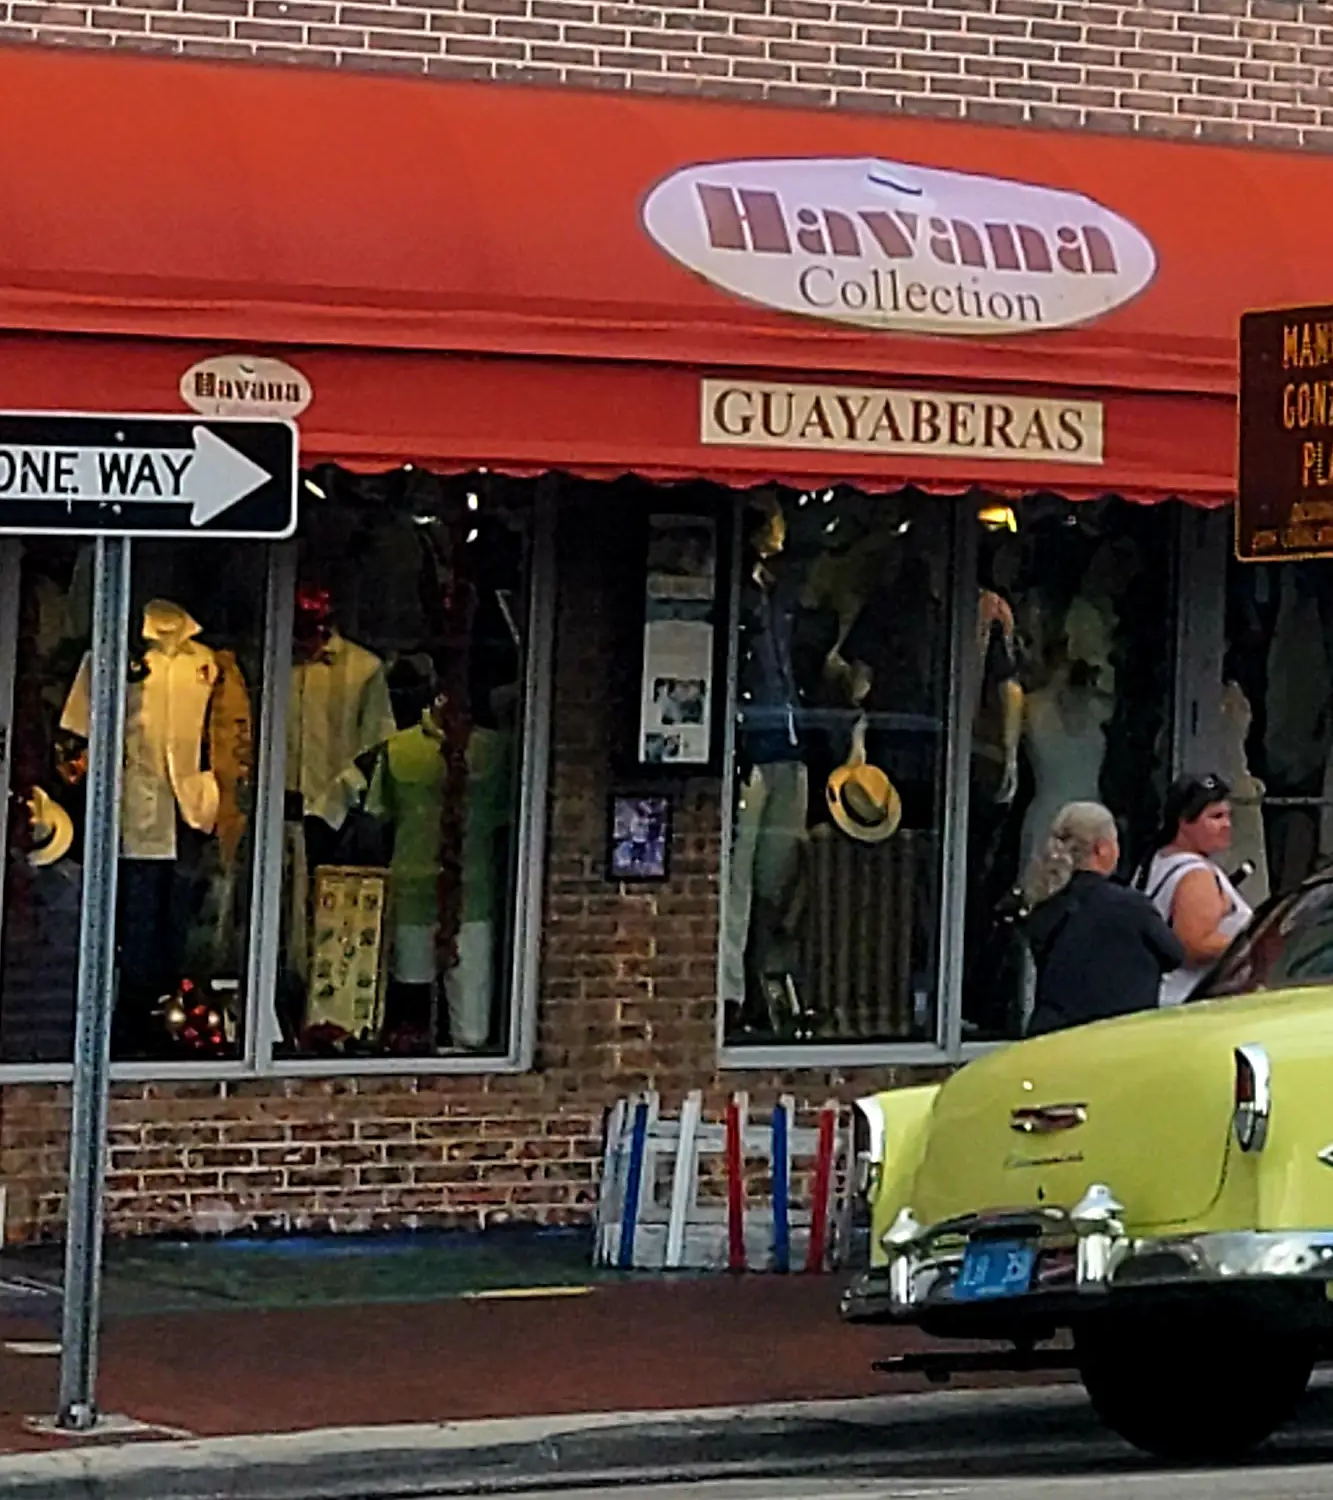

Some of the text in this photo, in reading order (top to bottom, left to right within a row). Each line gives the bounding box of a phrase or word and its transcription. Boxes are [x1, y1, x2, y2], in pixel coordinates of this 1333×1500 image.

[695, 182, 1118, 275] Havana
[798, 264, 1043, 323] Collection
[194, 371, 301, 403] Havana
[713, 388, 1084, 452] GUAYABERAS
[99, 453, 194, 496] WAY
